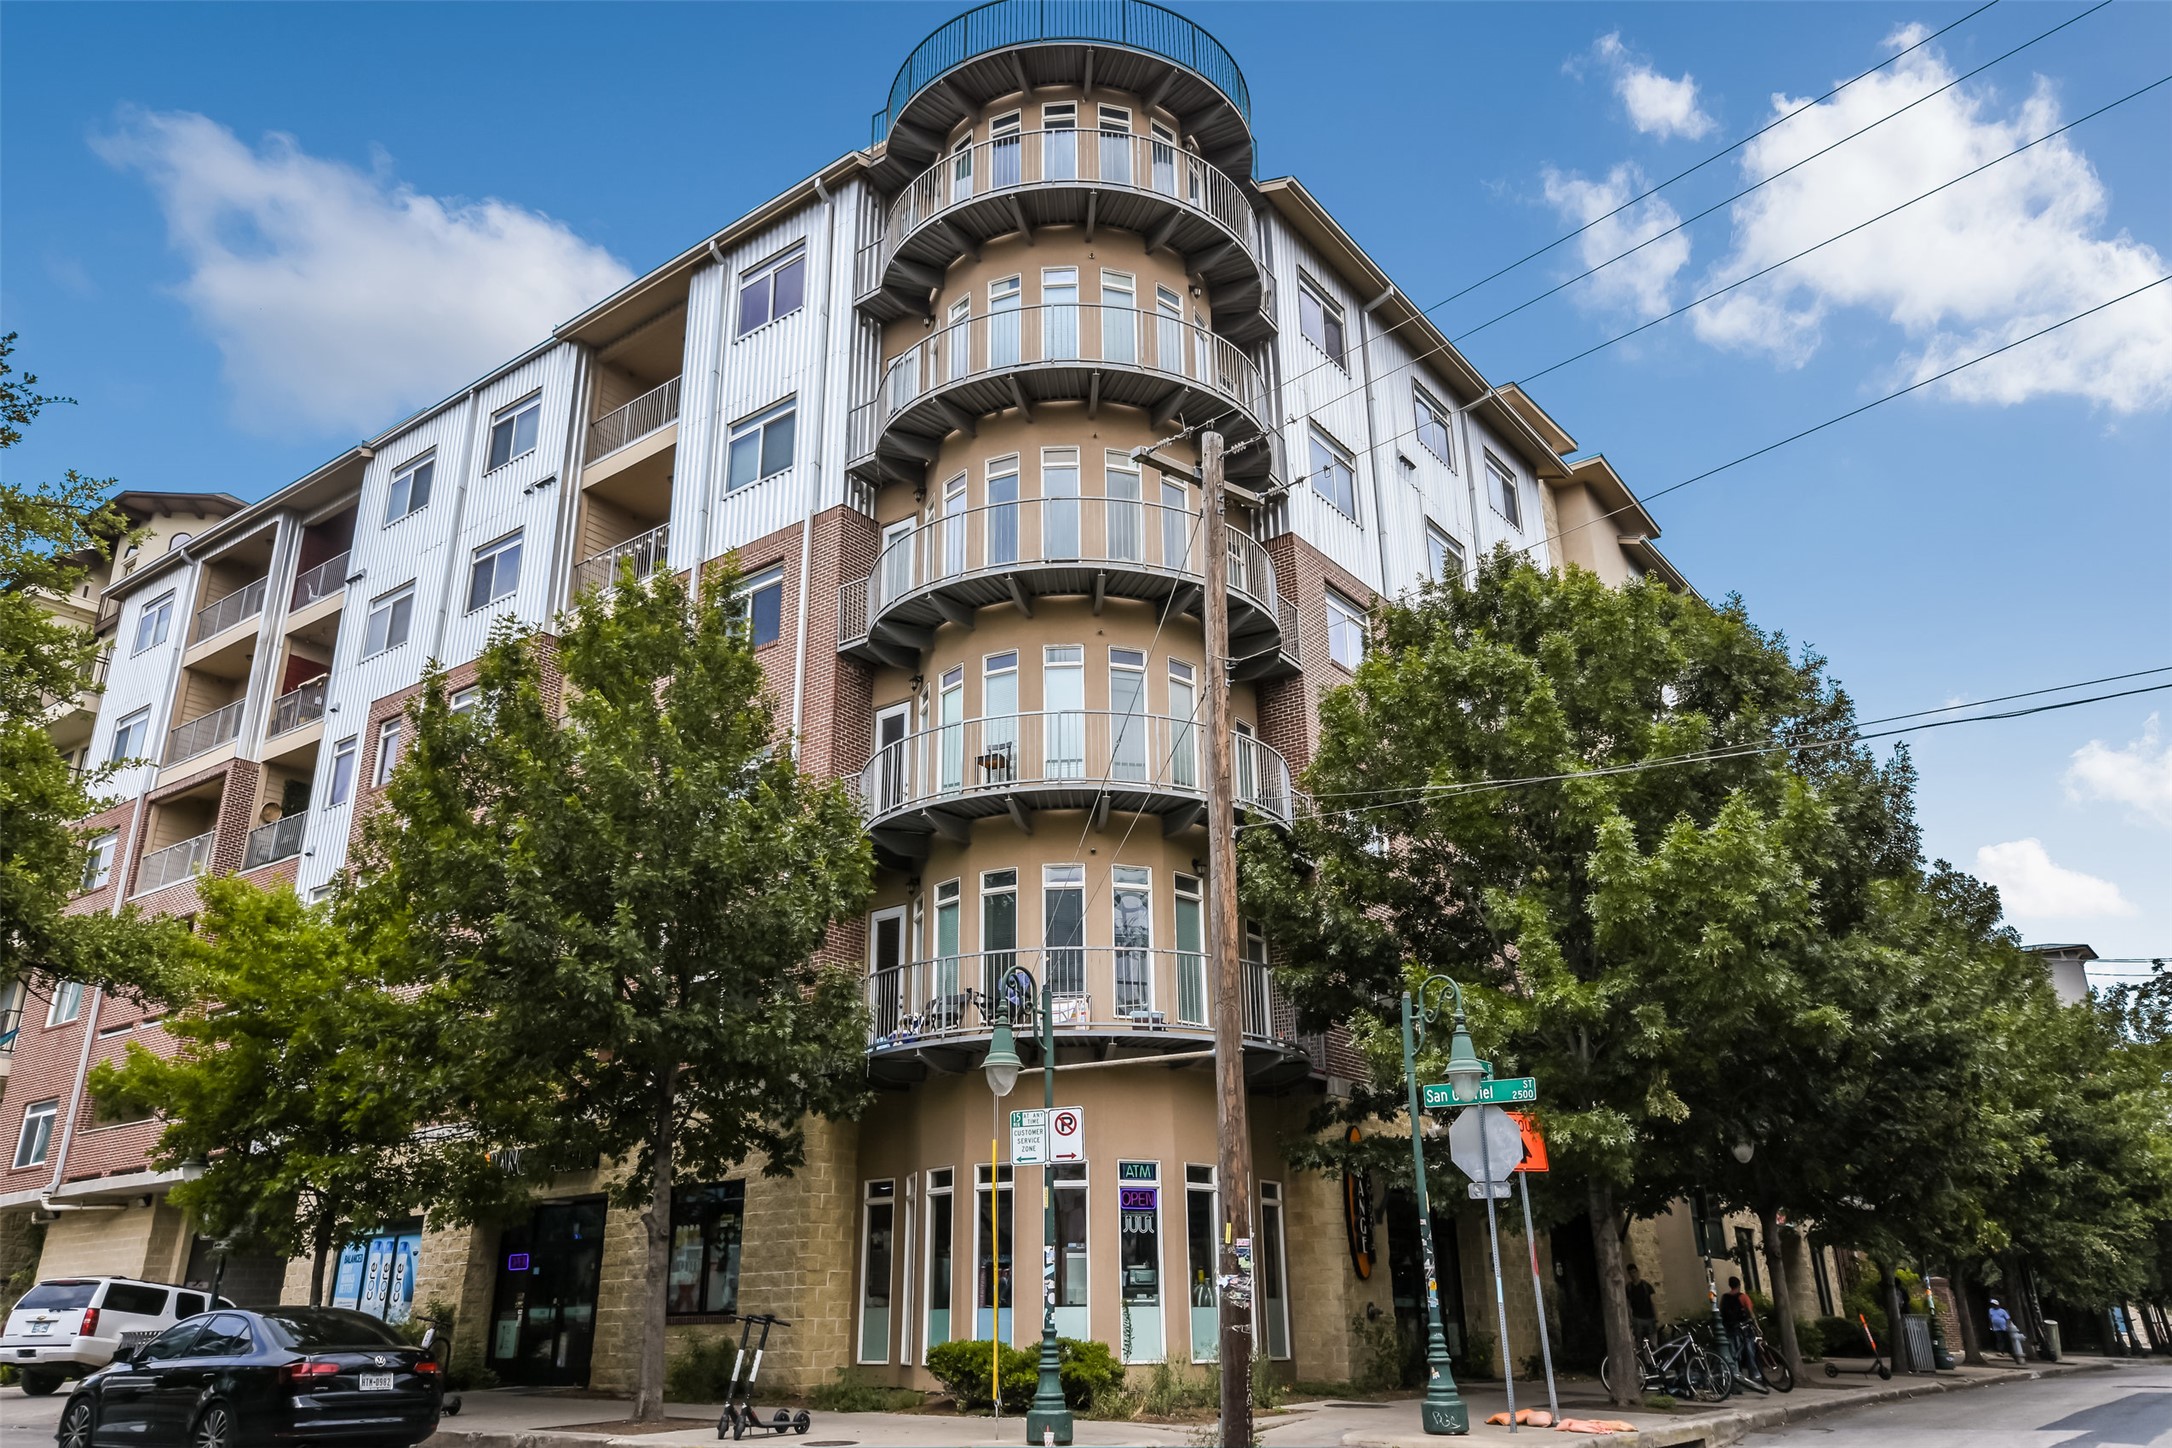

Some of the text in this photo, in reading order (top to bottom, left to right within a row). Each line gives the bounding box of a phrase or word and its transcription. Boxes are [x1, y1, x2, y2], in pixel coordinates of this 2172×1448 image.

[1522, 1080, 1532, 1088] ST
[1426, 1089, 1448, 1103] San
[1512, 1090, 1534, 1099] 2500
[1013, 1112, 1021, 1122] 15
[1125, 1165, 1151, 1178] ATM
[1122, 1191, 1154, 1206] OPEN
[1123, 1215, 1155, 1233] JUUL
[366, 1262, 378, 1301] core
[379, 1262, 390, 1302] core
[393, 1263, 404, 1303] core
